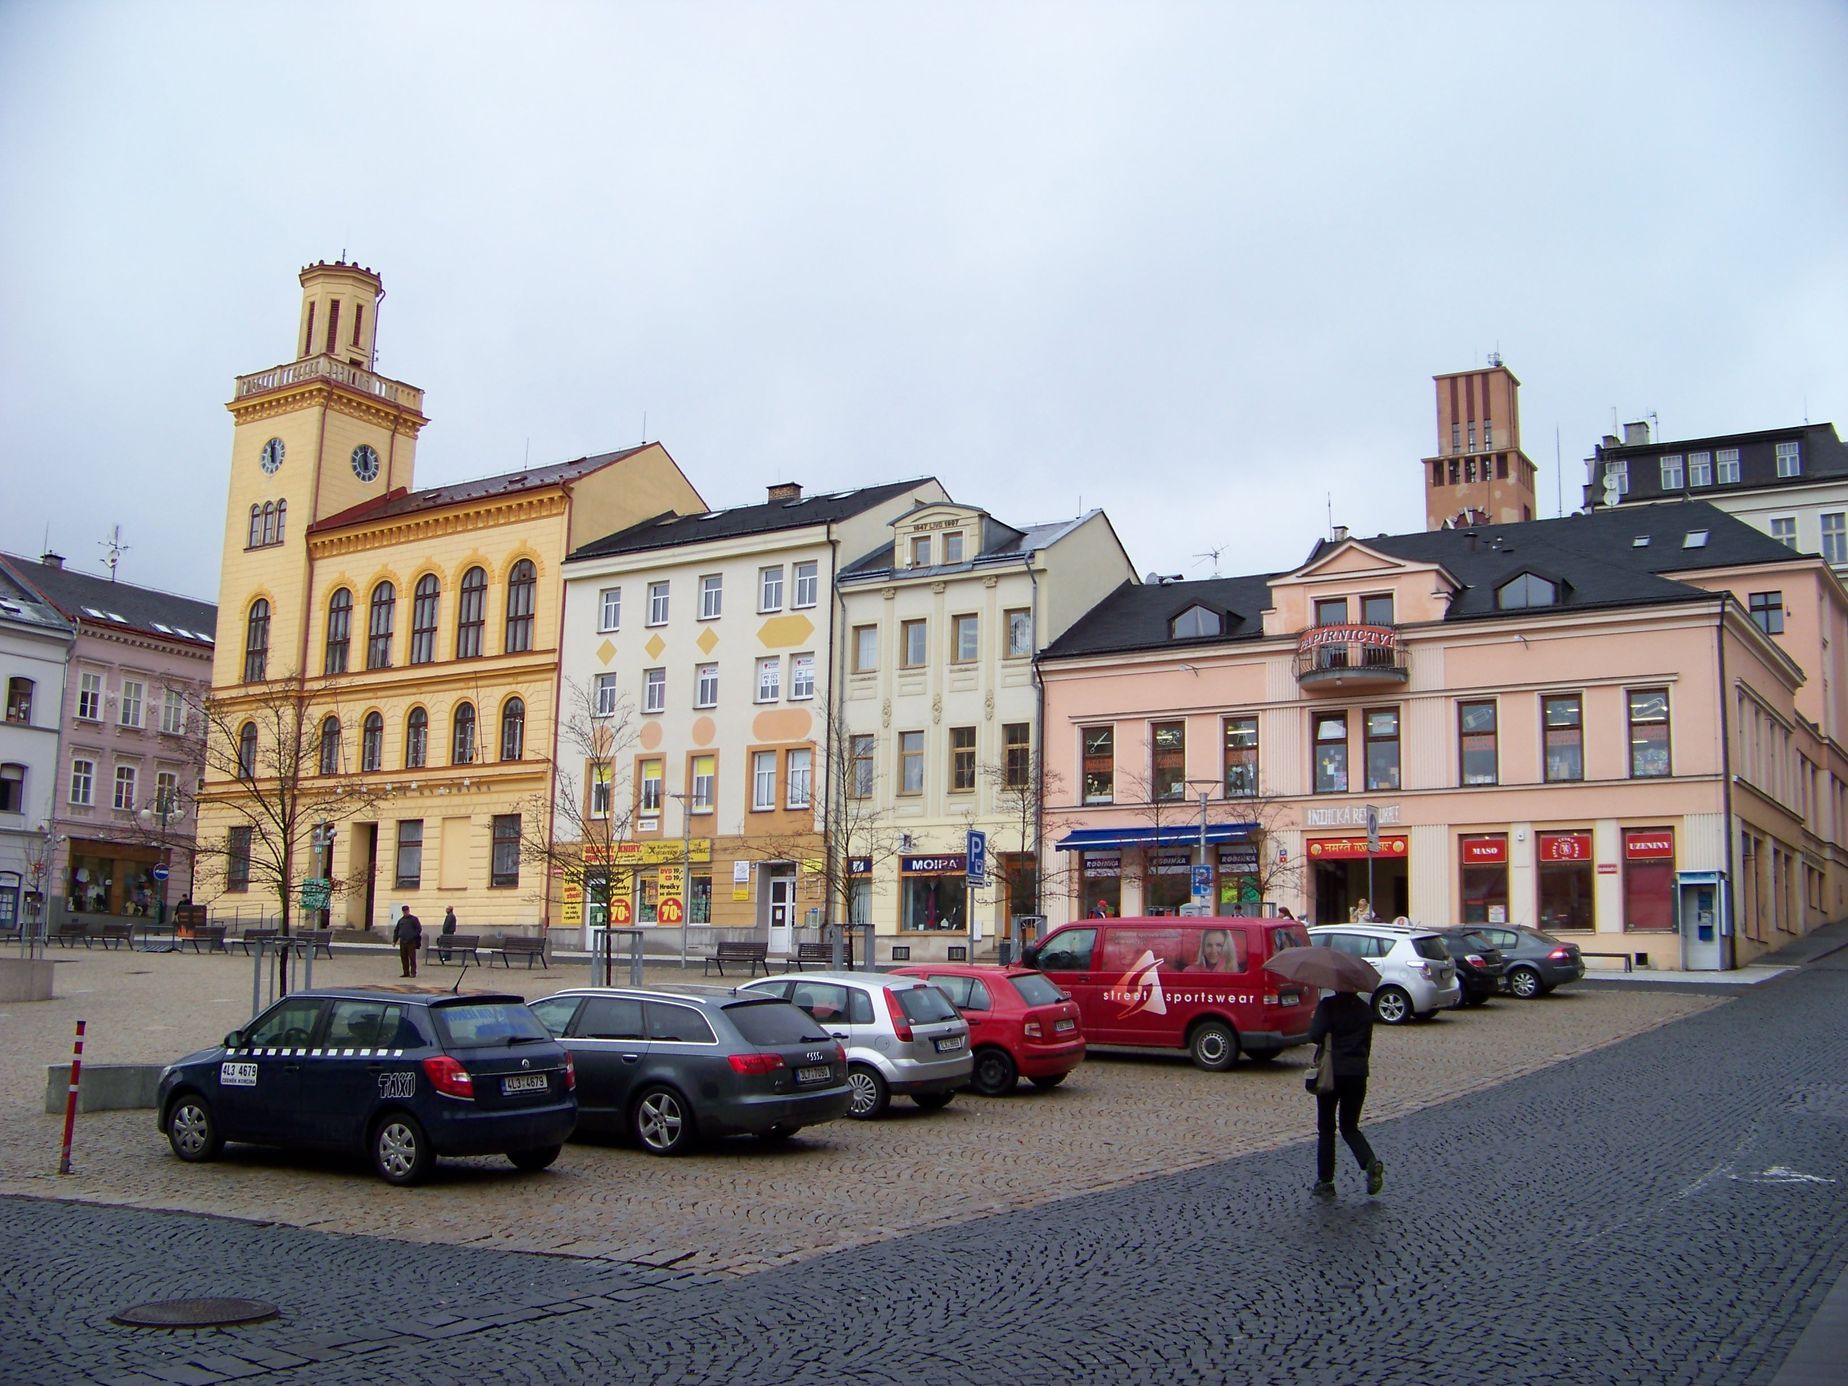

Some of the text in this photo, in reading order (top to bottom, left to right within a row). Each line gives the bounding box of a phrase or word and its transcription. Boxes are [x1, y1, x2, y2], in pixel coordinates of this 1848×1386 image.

[971, 836, 982, 862] P
[1472, 847, 1498, 855] MASO
[1629, 841, 1670, 850] UZENINY
[1103, 990, 1255, 1004] street sportswear
[222, 1064, 257, 1077] 4L3 4679
[378, 1072, 416, 1098] TAXI
[507, 1075, 545, 1090] 4L3 4679
